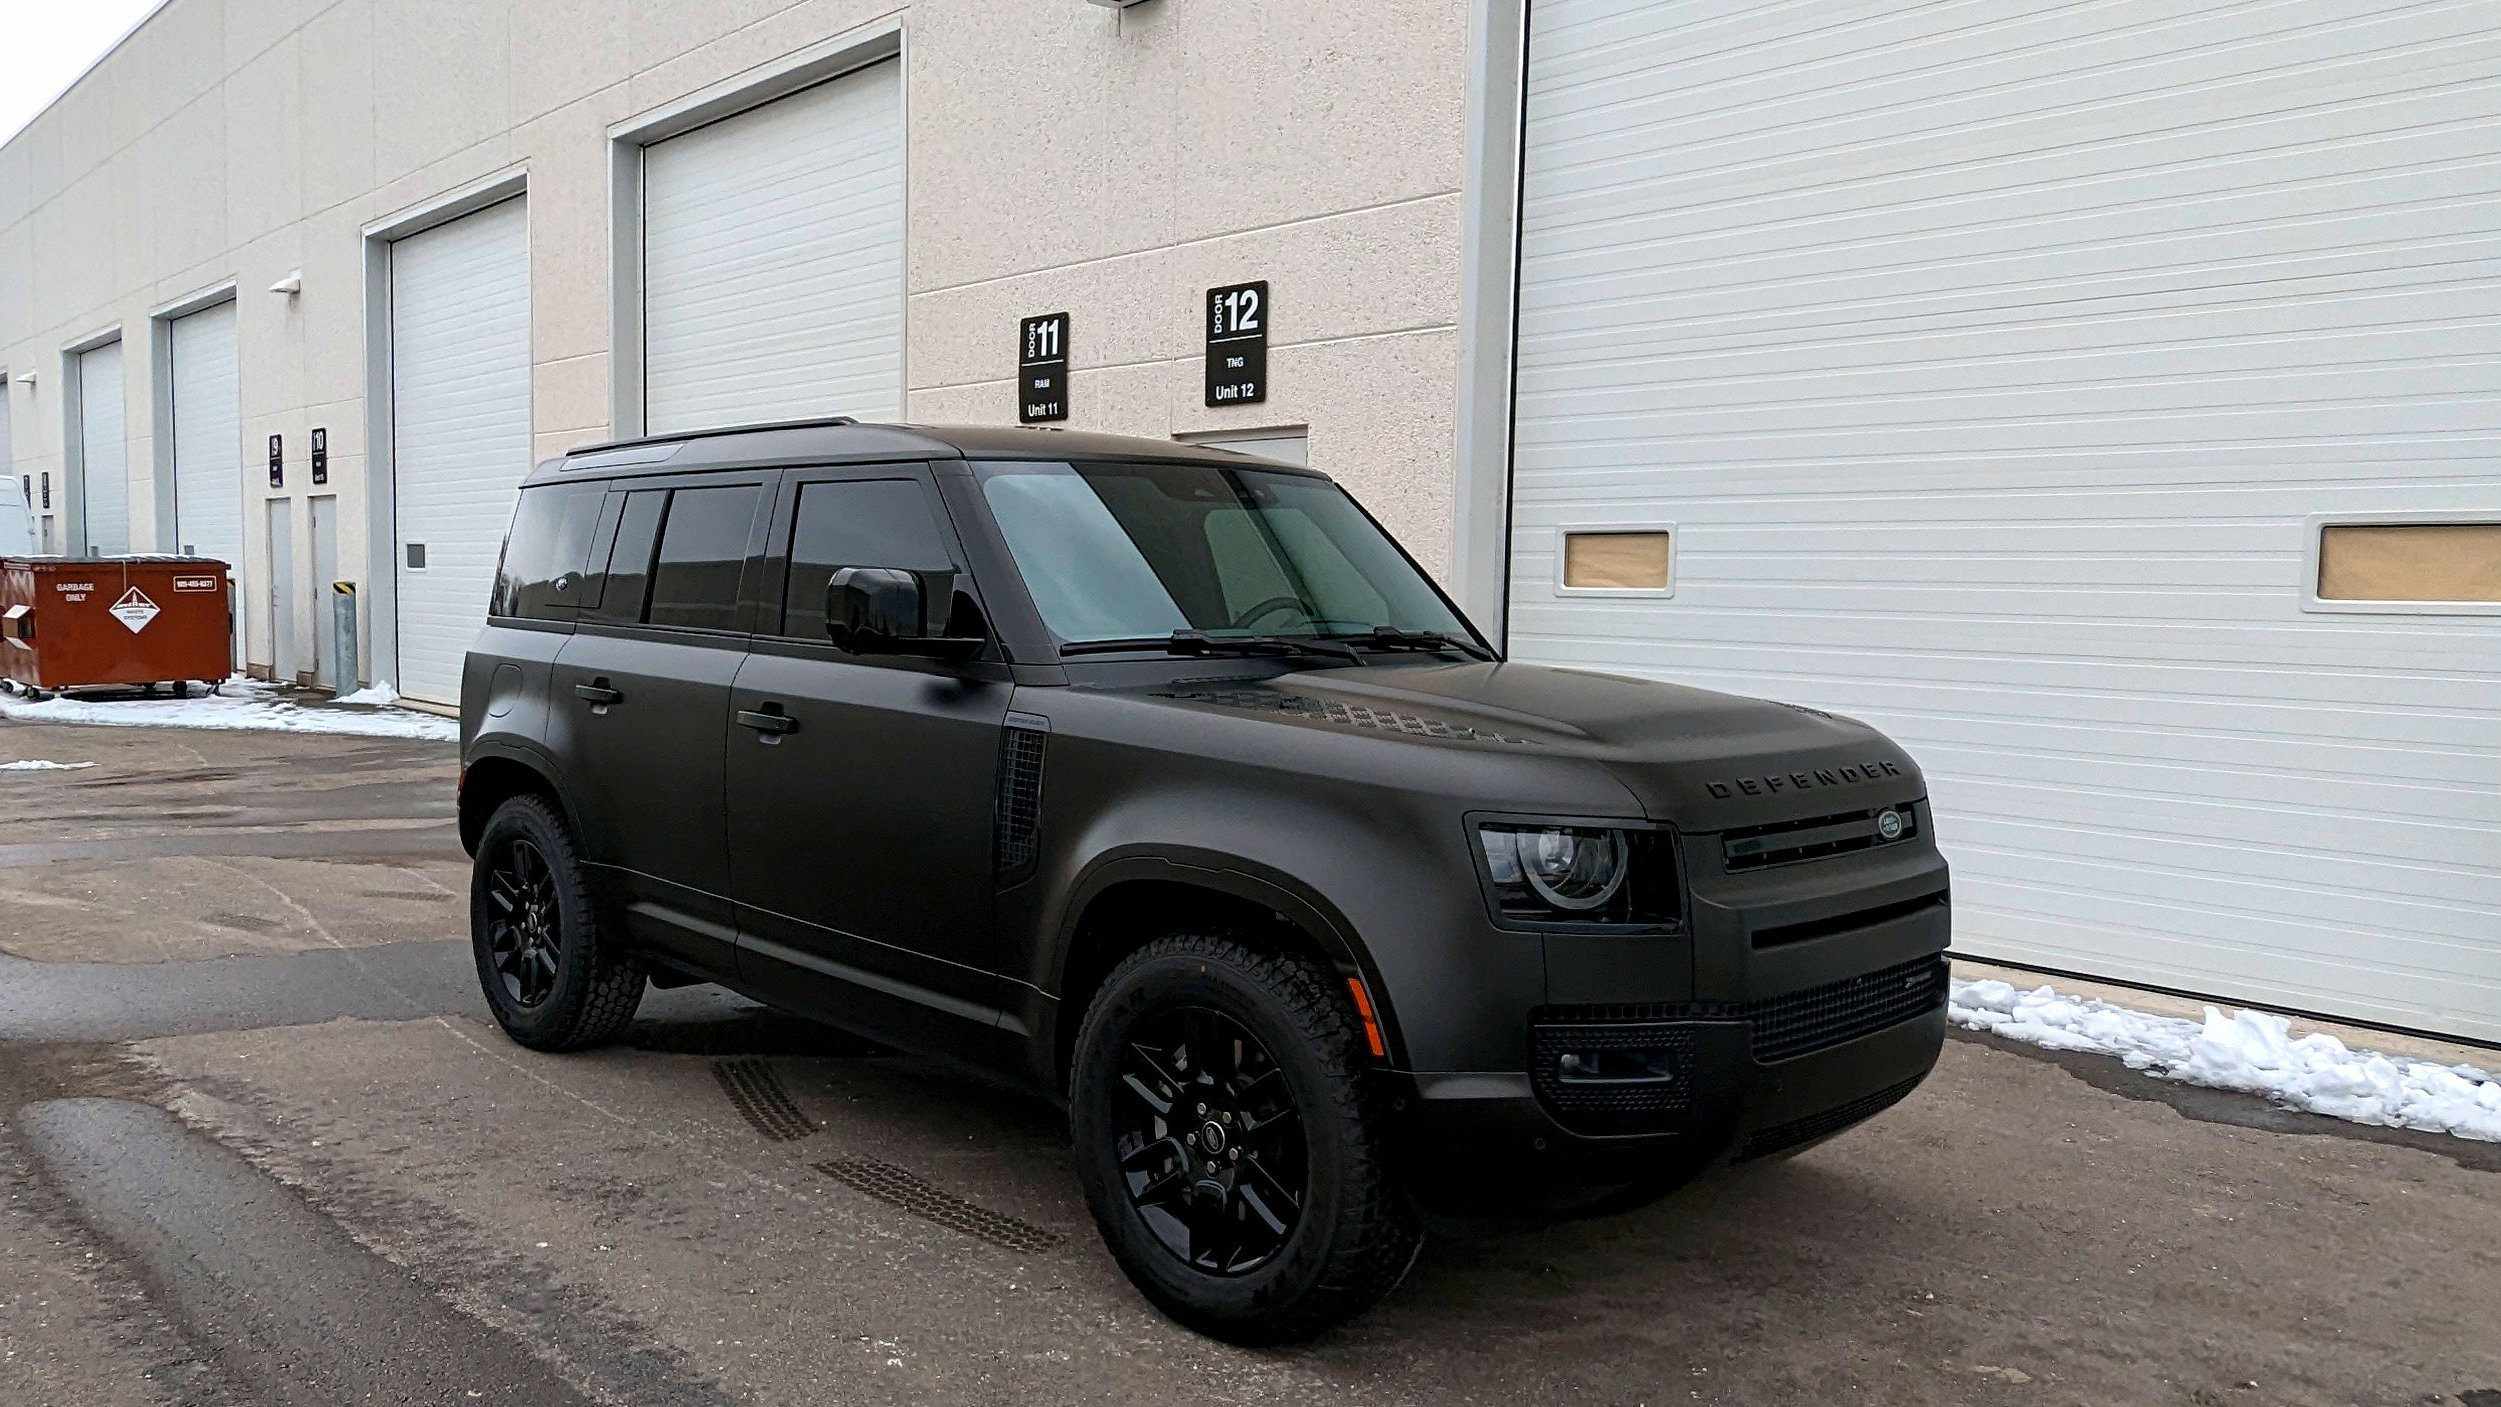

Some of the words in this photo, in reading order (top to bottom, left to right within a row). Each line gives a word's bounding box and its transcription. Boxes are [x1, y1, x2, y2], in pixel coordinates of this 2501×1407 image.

[1214, 293, 1223, 334] DOOR
[1224, 289, 1259, 332] 12
[1027, 323, 1036, 358] DOOR
[1037, 319, 1059, 357] 11
[1215, 384, 1239, 400] Unit
[1241, 382, 1255, 398] 12
[1028, 403, 1047, 417] Unit
[1048, 402, 1058, 415] 11
[56, 583, 96, 591] GARBAGE
[1706, 760, 1901, 799] DEFENDER
